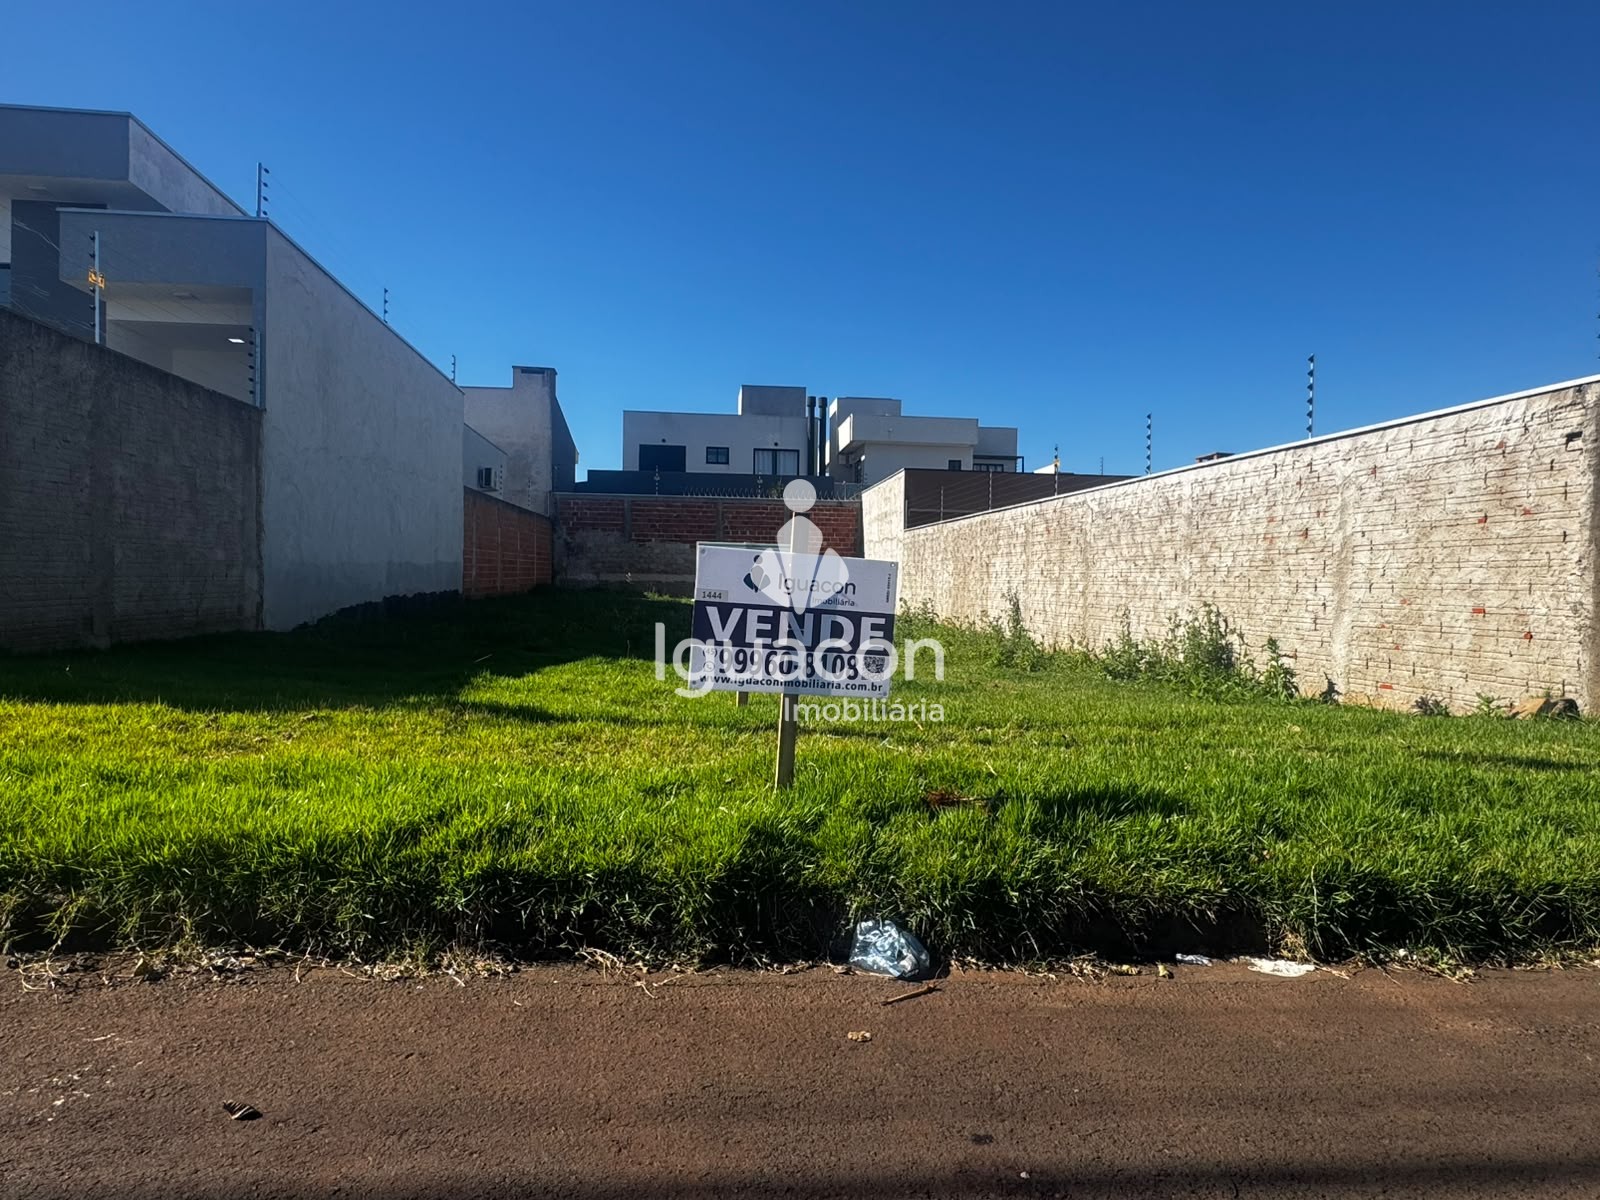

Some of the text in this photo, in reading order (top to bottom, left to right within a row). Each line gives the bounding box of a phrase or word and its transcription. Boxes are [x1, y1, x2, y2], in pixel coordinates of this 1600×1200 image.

[778, 573, 857, 595] Iguacon
[702, 591, 722, 600] 1444
[705, 606, 886, 651] VENDE
[718, 648, 859, 681] 99960-8108
[700, 675, 884, 693] www.iguaconimobiliaria.com.br
